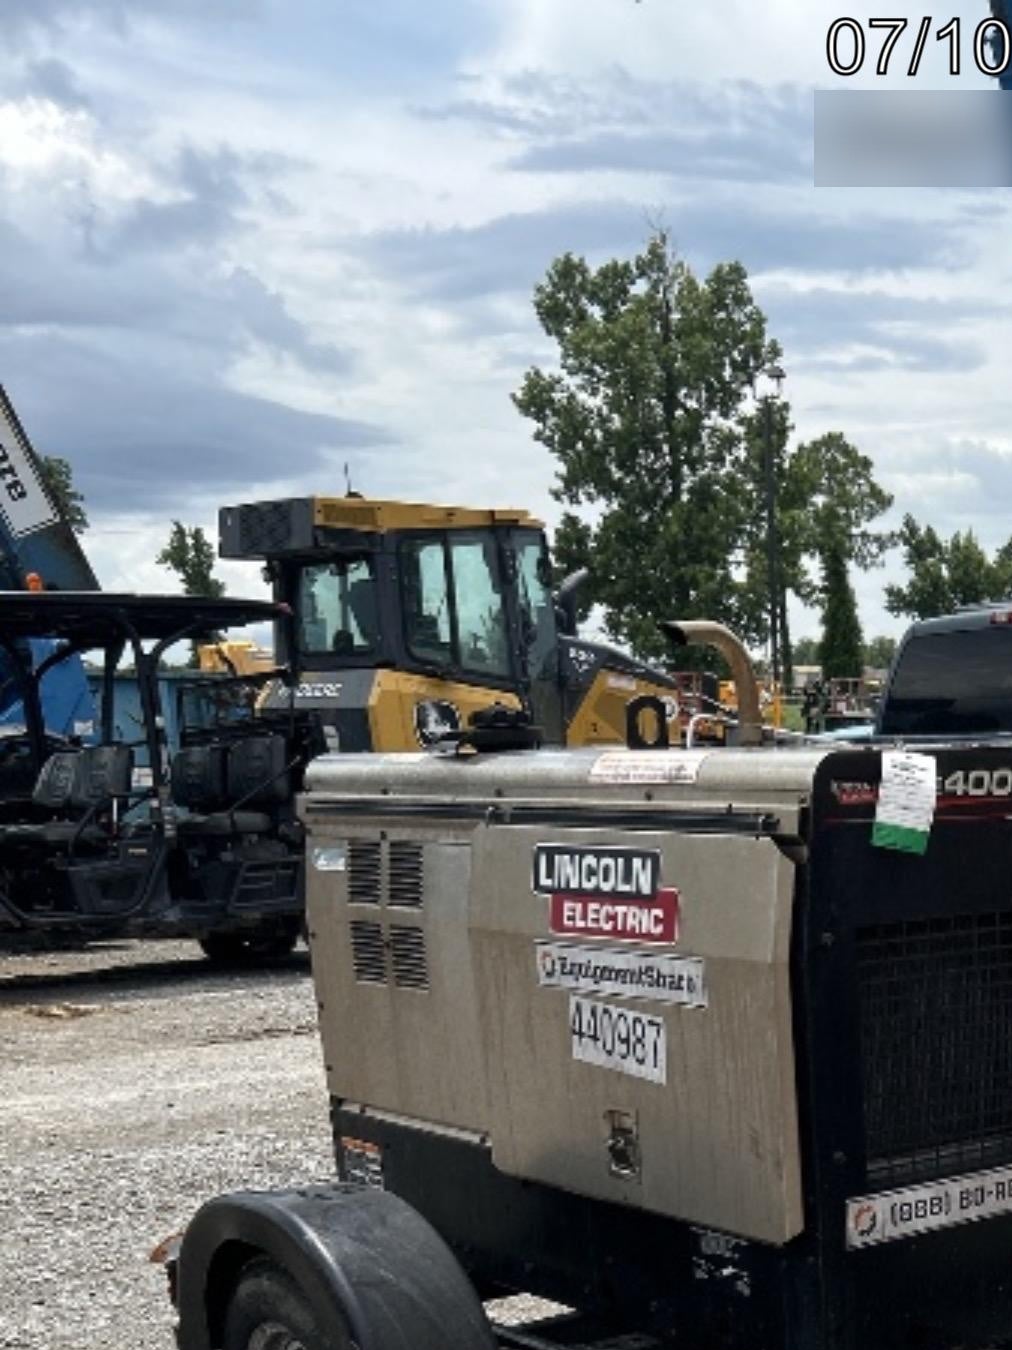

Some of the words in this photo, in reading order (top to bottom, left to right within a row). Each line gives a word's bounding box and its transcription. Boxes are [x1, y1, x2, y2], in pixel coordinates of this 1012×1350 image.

[538, 853, 653, 895] LINCOLN
[562, 900, 665, 935] ELECTRIC
[571, 1001, 663, 1069] 440987
